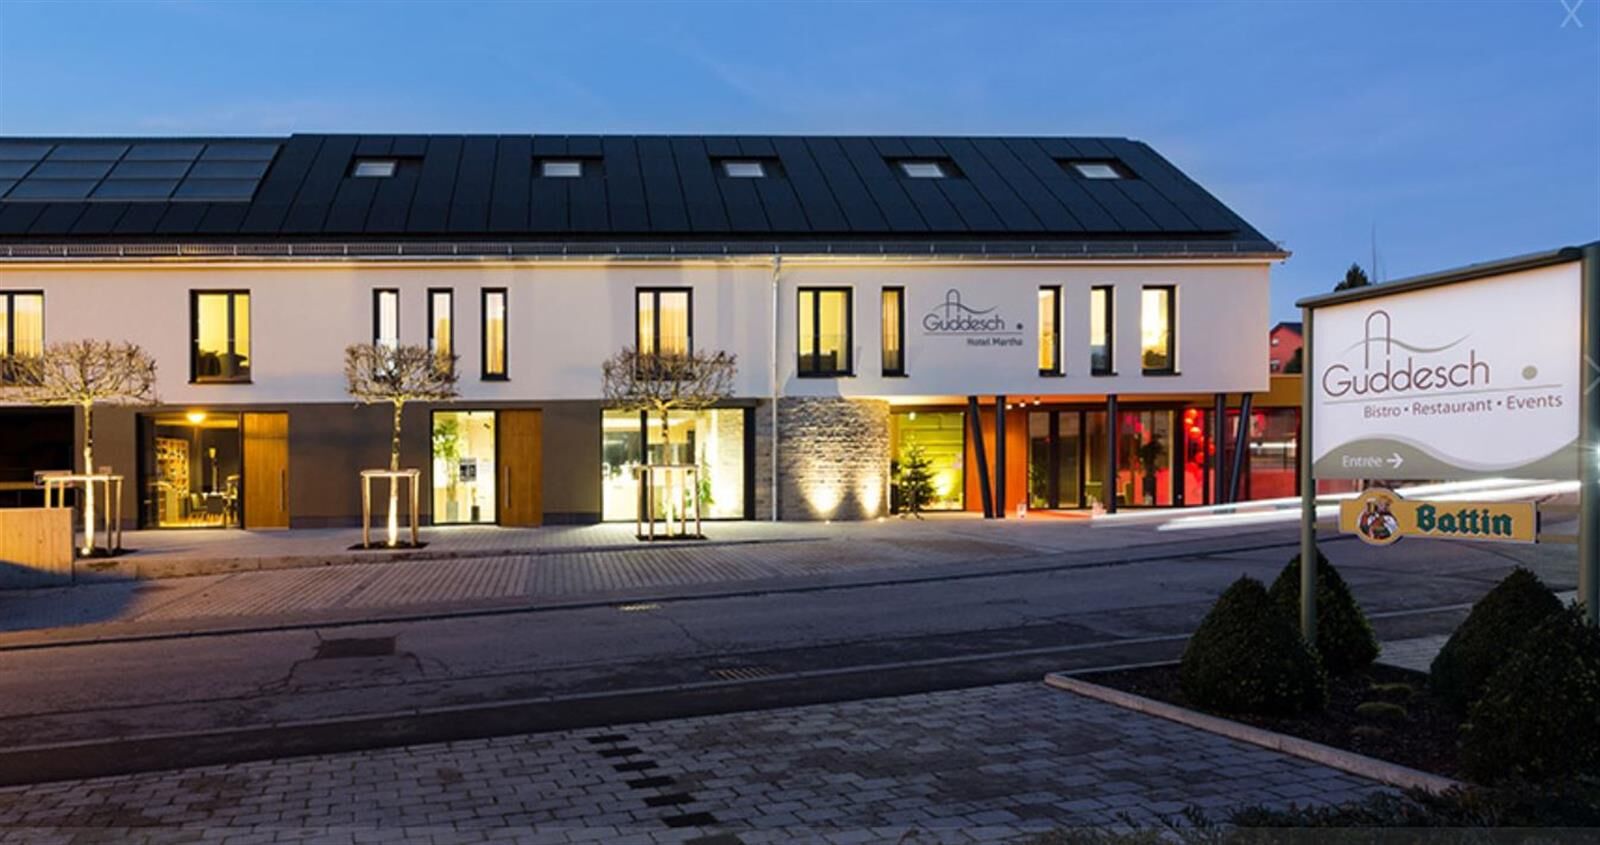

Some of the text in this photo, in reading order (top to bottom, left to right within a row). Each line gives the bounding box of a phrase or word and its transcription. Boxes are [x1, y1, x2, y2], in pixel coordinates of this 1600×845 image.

[922, 313, 1005, 332] Guddesch
[967, 336, 990, 346] Hotel
[1322, 349, 1490, 397] Guddesch
[1363, 394, 1563, 419] Bistro Restaurant Events
[1415, 503, 1512, 536] Battin
